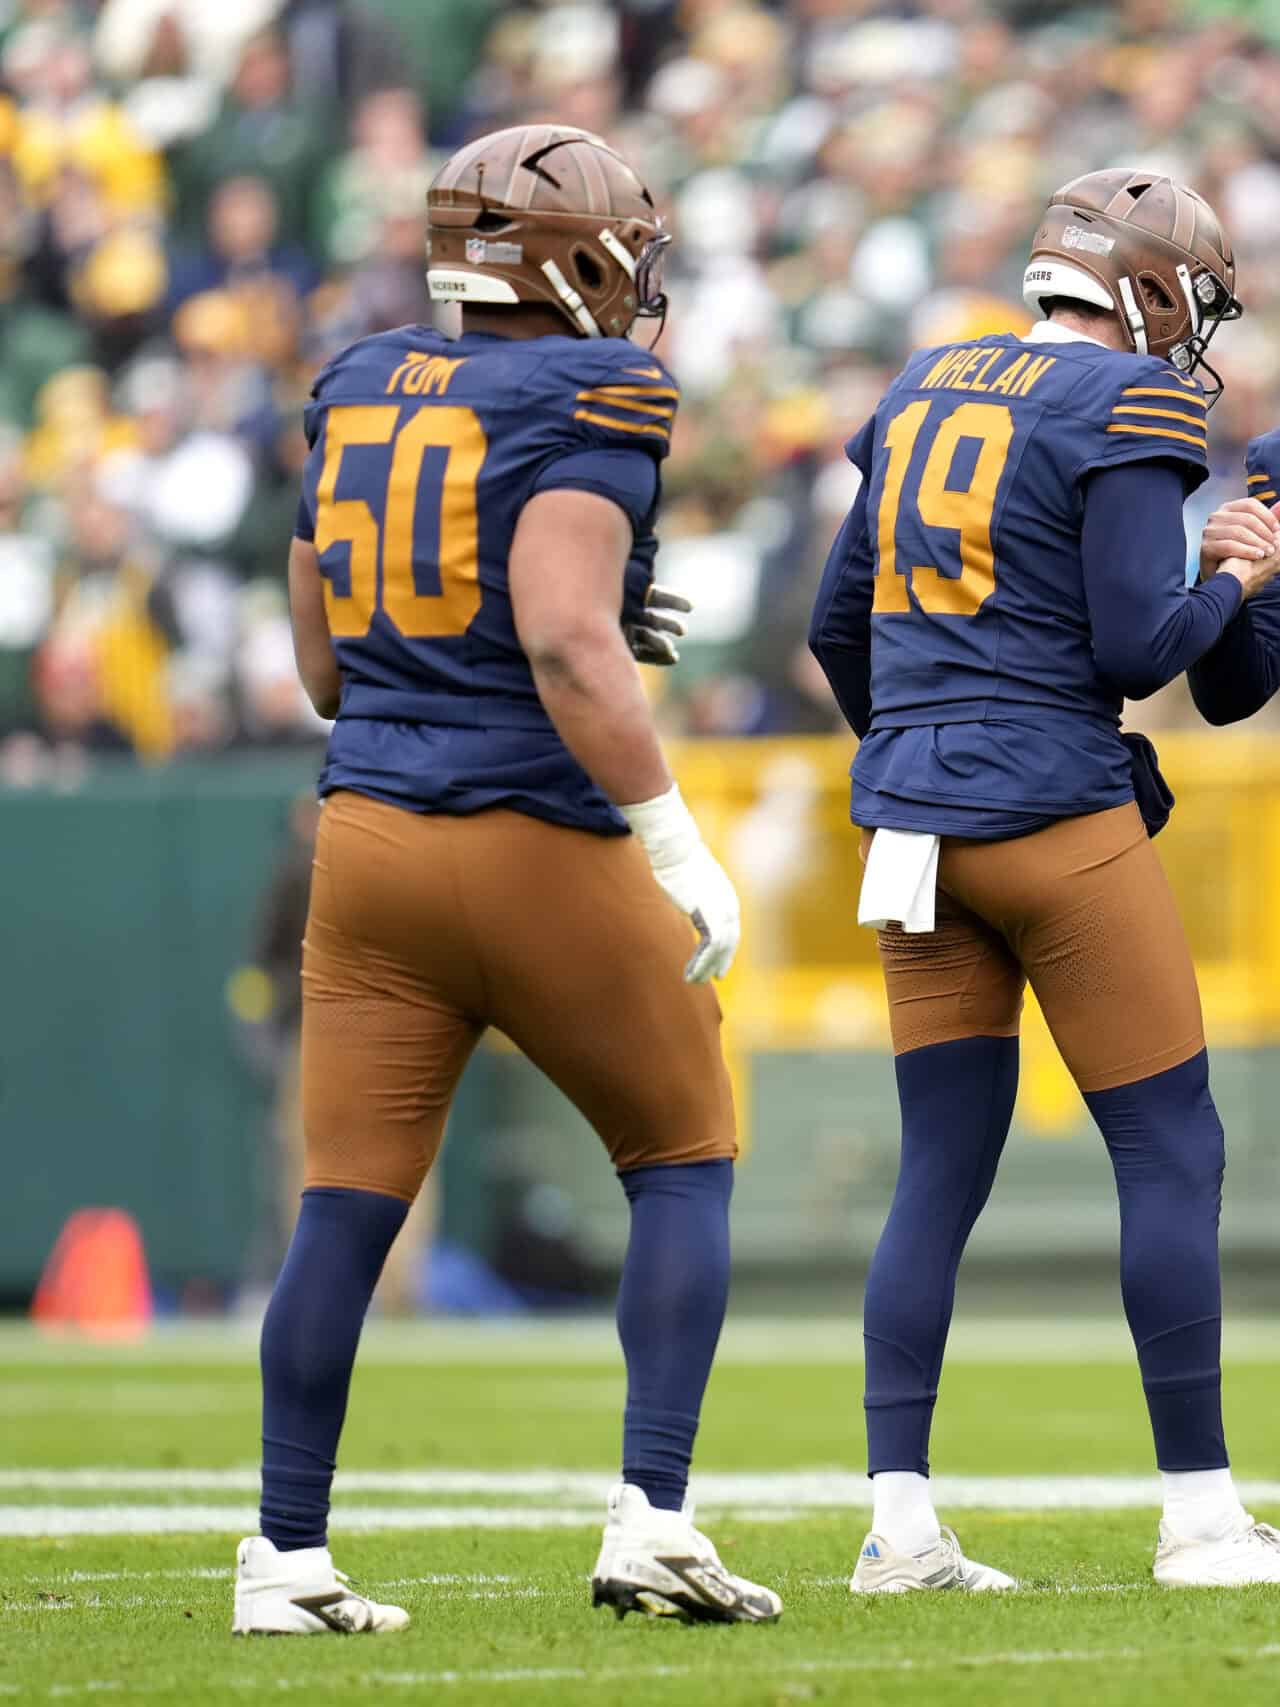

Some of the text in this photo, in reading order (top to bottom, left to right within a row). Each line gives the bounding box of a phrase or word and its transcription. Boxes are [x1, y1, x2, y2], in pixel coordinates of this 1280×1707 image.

[385, 352, 466, 396] TOM
[919, 347, 1056, 397] WHELAN
[314, 405, 488, 638] 50
[871, 399, 1014, 616] 19
